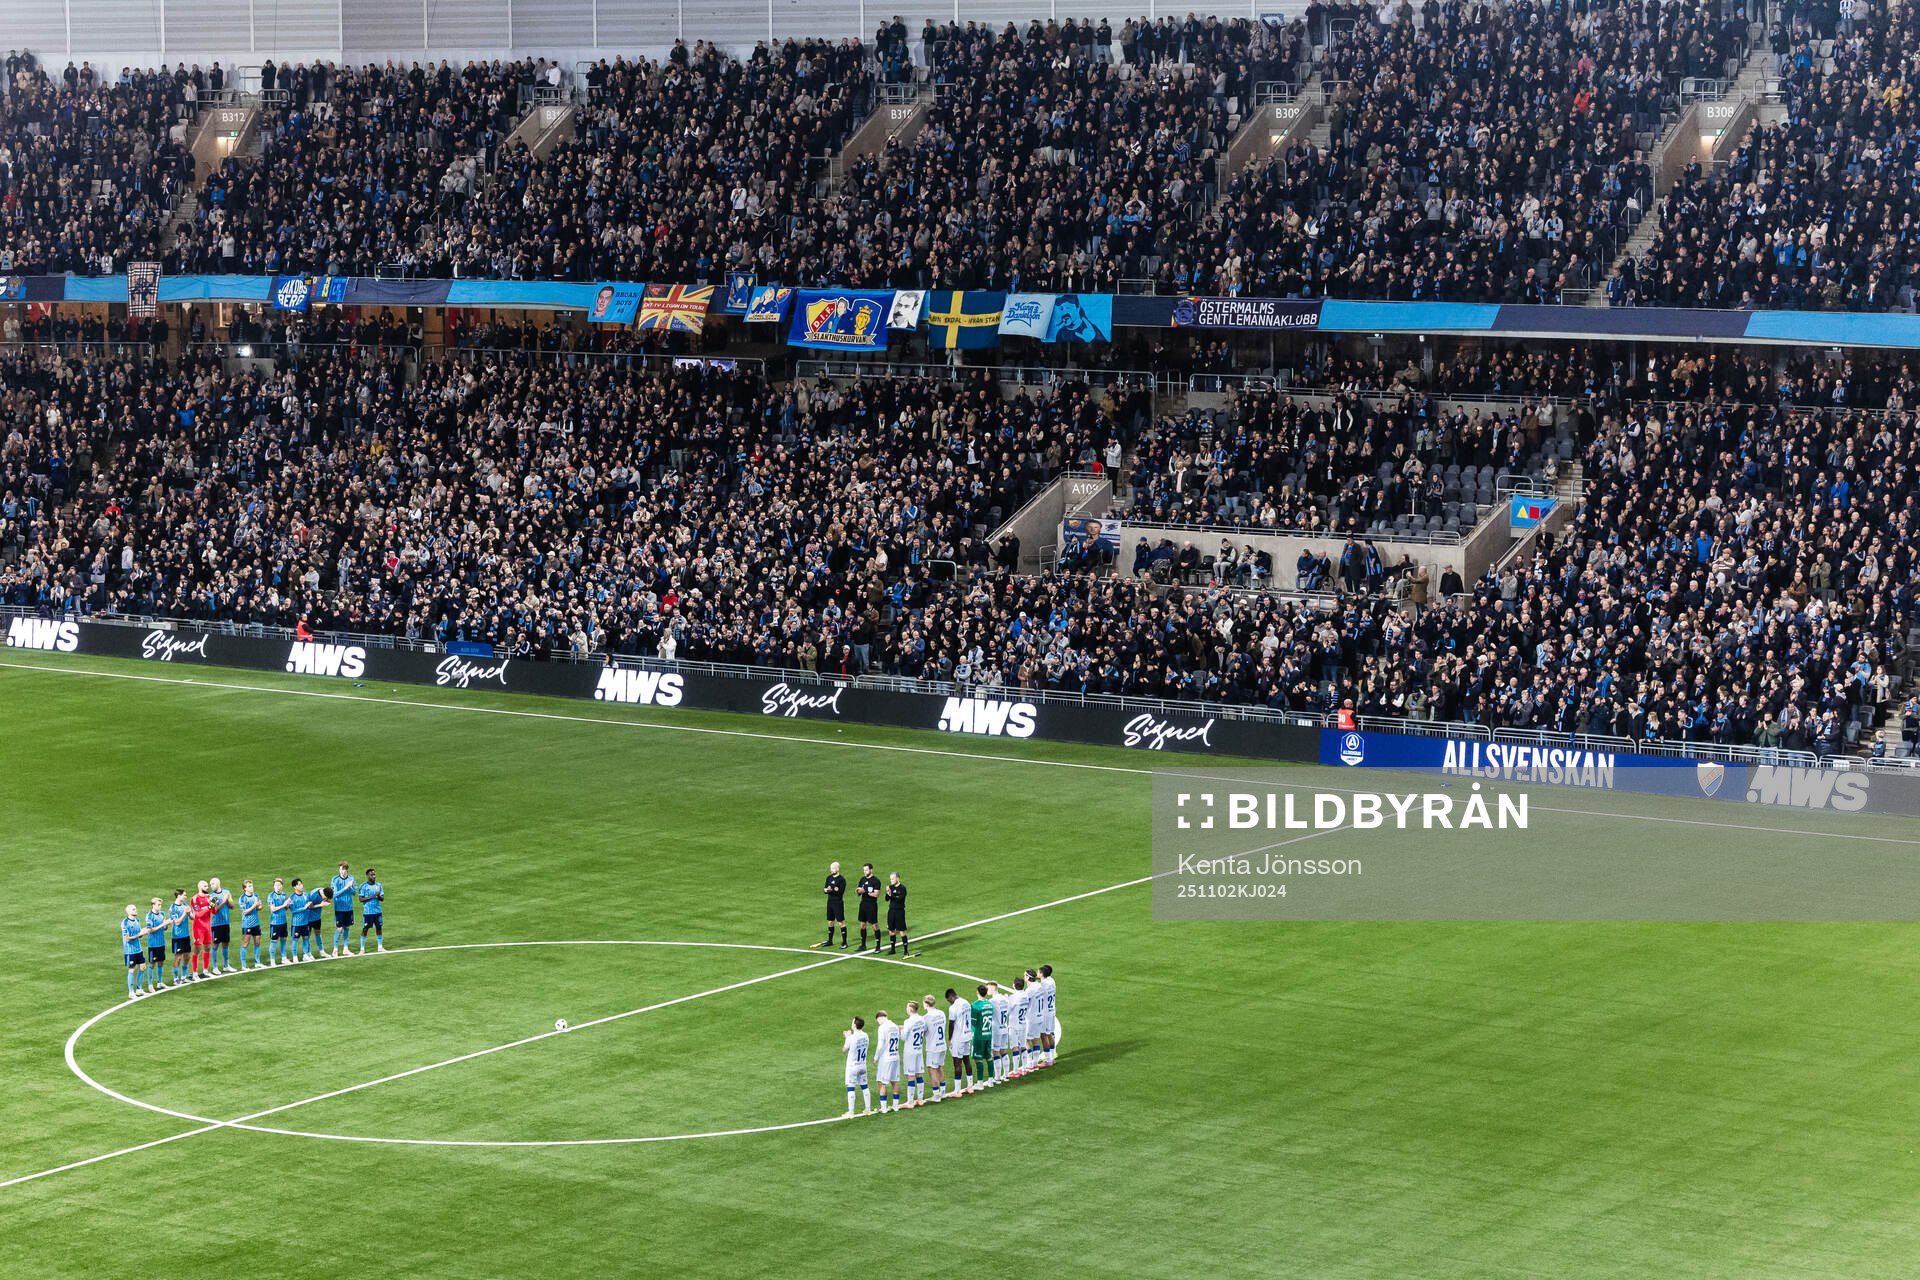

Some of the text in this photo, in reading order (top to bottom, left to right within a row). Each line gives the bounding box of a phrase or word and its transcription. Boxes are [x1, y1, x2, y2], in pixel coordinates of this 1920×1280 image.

[222, 112, 246, 122] B312
[1707, 106, 1734, 118] B308
[278, 279, 308, 295] JAKOBS
[1200, 299, 1275, 315] ÖSTERMALMS
[1198, 313, 1318, 327] GENTLEMANNAKLUBB
[140, 628, 209, 661] Signed
[435, 654, 512, 688] Signed
[761, 681, 844, 718] Signed
[1123, 713, 1216, 750] Signed
[1441, 739, 1615, 789] ALLSVENSKAN
[937, 1026, 944, 1041] 9
[856, 1047, 867, 1062] 14
